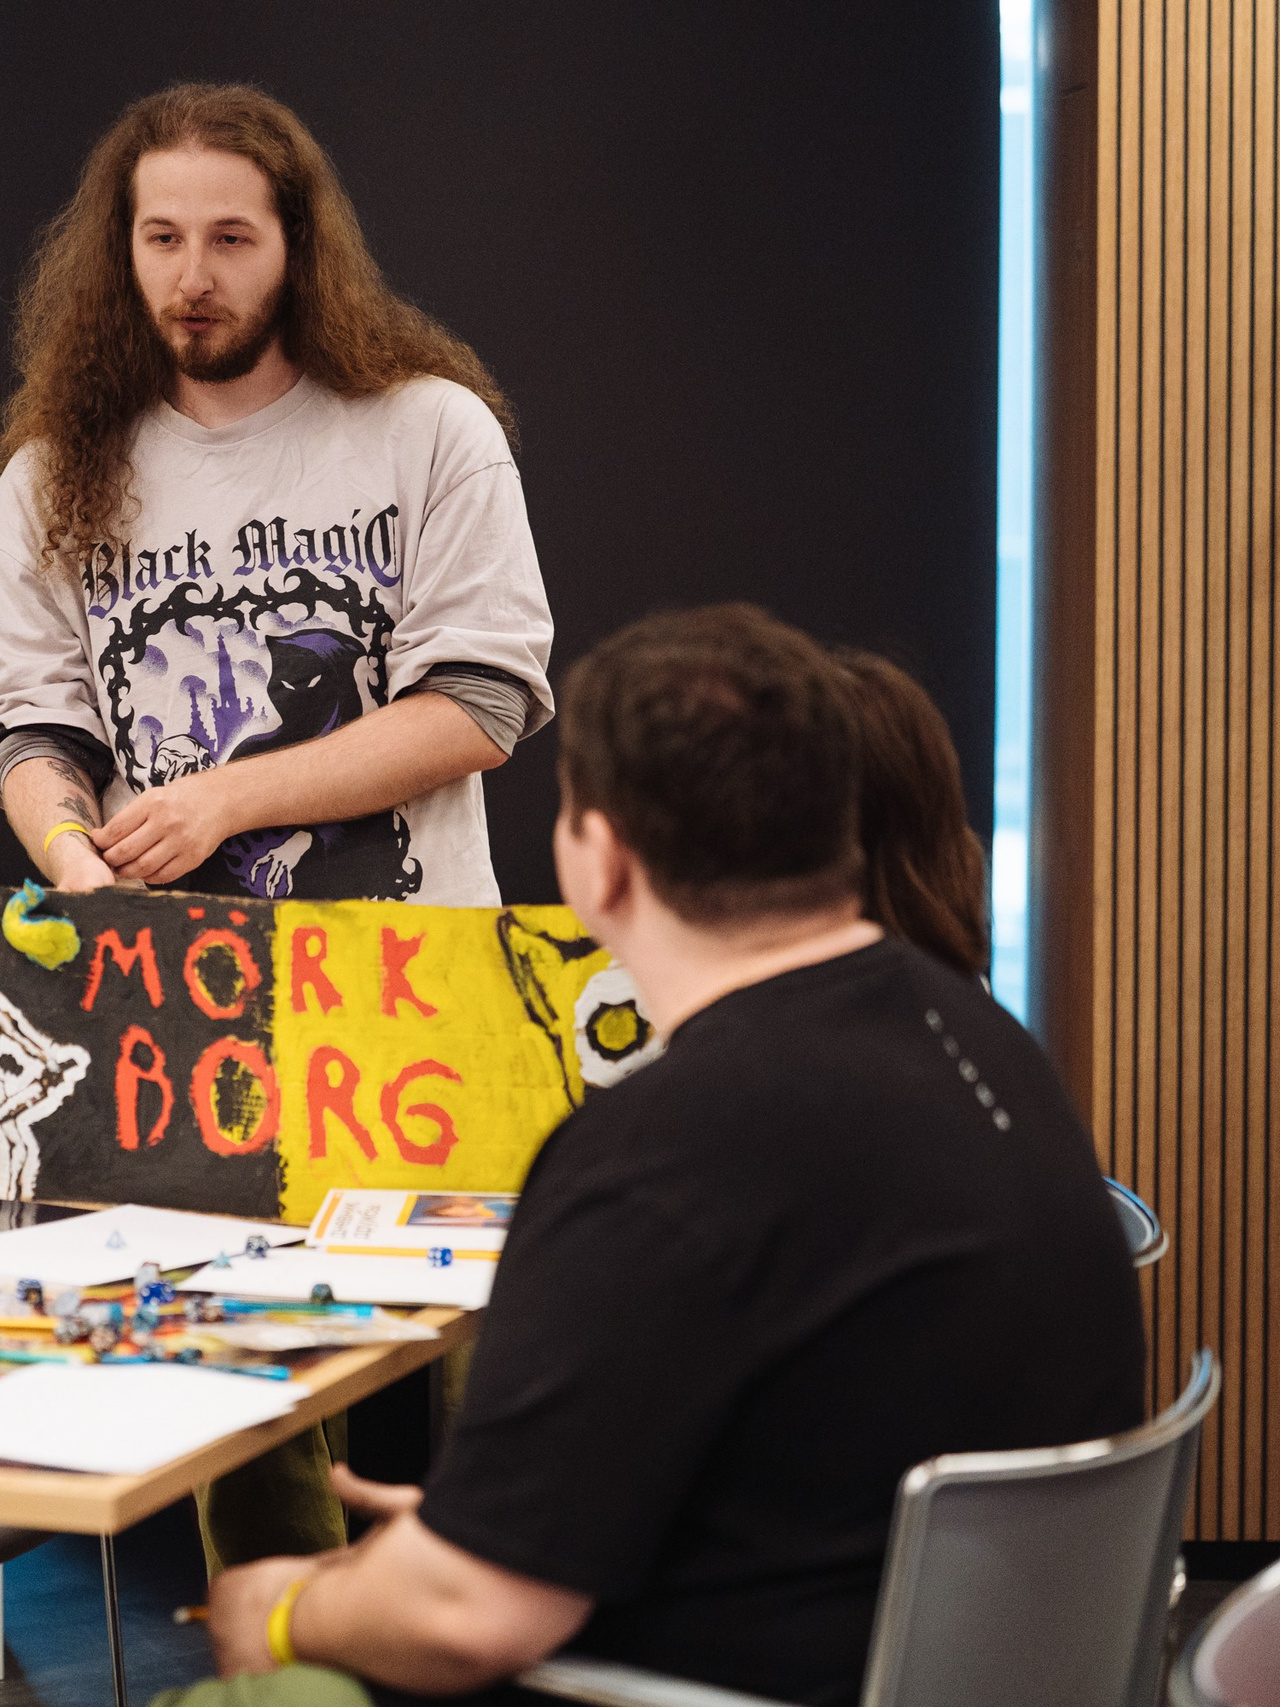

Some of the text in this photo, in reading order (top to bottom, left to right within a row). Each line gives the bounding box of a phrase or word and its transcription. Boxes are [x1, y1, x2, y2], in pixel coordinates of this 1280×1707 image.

[81, 529, 216, 618] Black
[80, 907, 438, 1019] MÖRK
[115, 1025, 464, 1166] BORG
